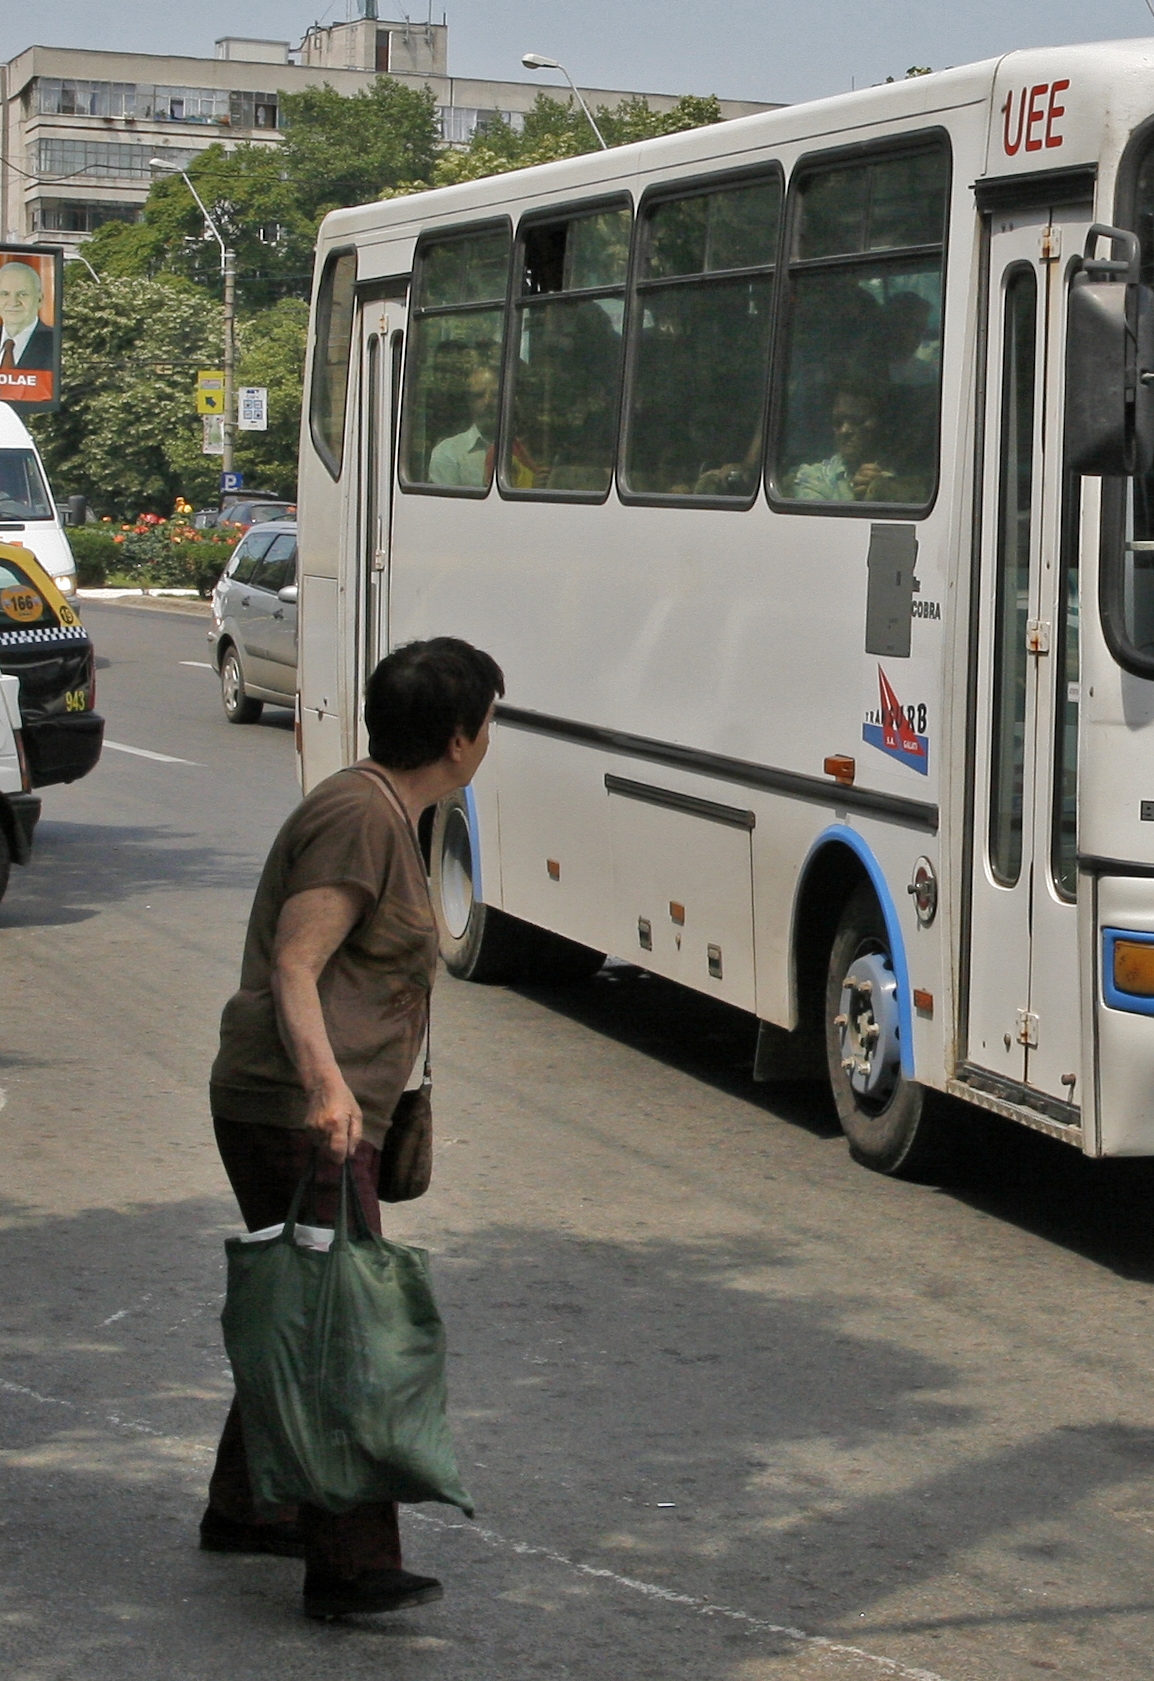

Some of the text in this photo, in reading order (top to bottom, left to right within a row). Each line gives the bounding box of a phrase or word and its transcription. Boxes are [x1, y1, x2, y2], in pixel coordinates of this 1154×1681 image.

[1003, 79, 1070, 156] UEE
[224, 474, 237, 489] P
[11, 595, 34, 611] 166
[911, 600, 941, 620] COBRA
[66, 690, 86, 713] 943
